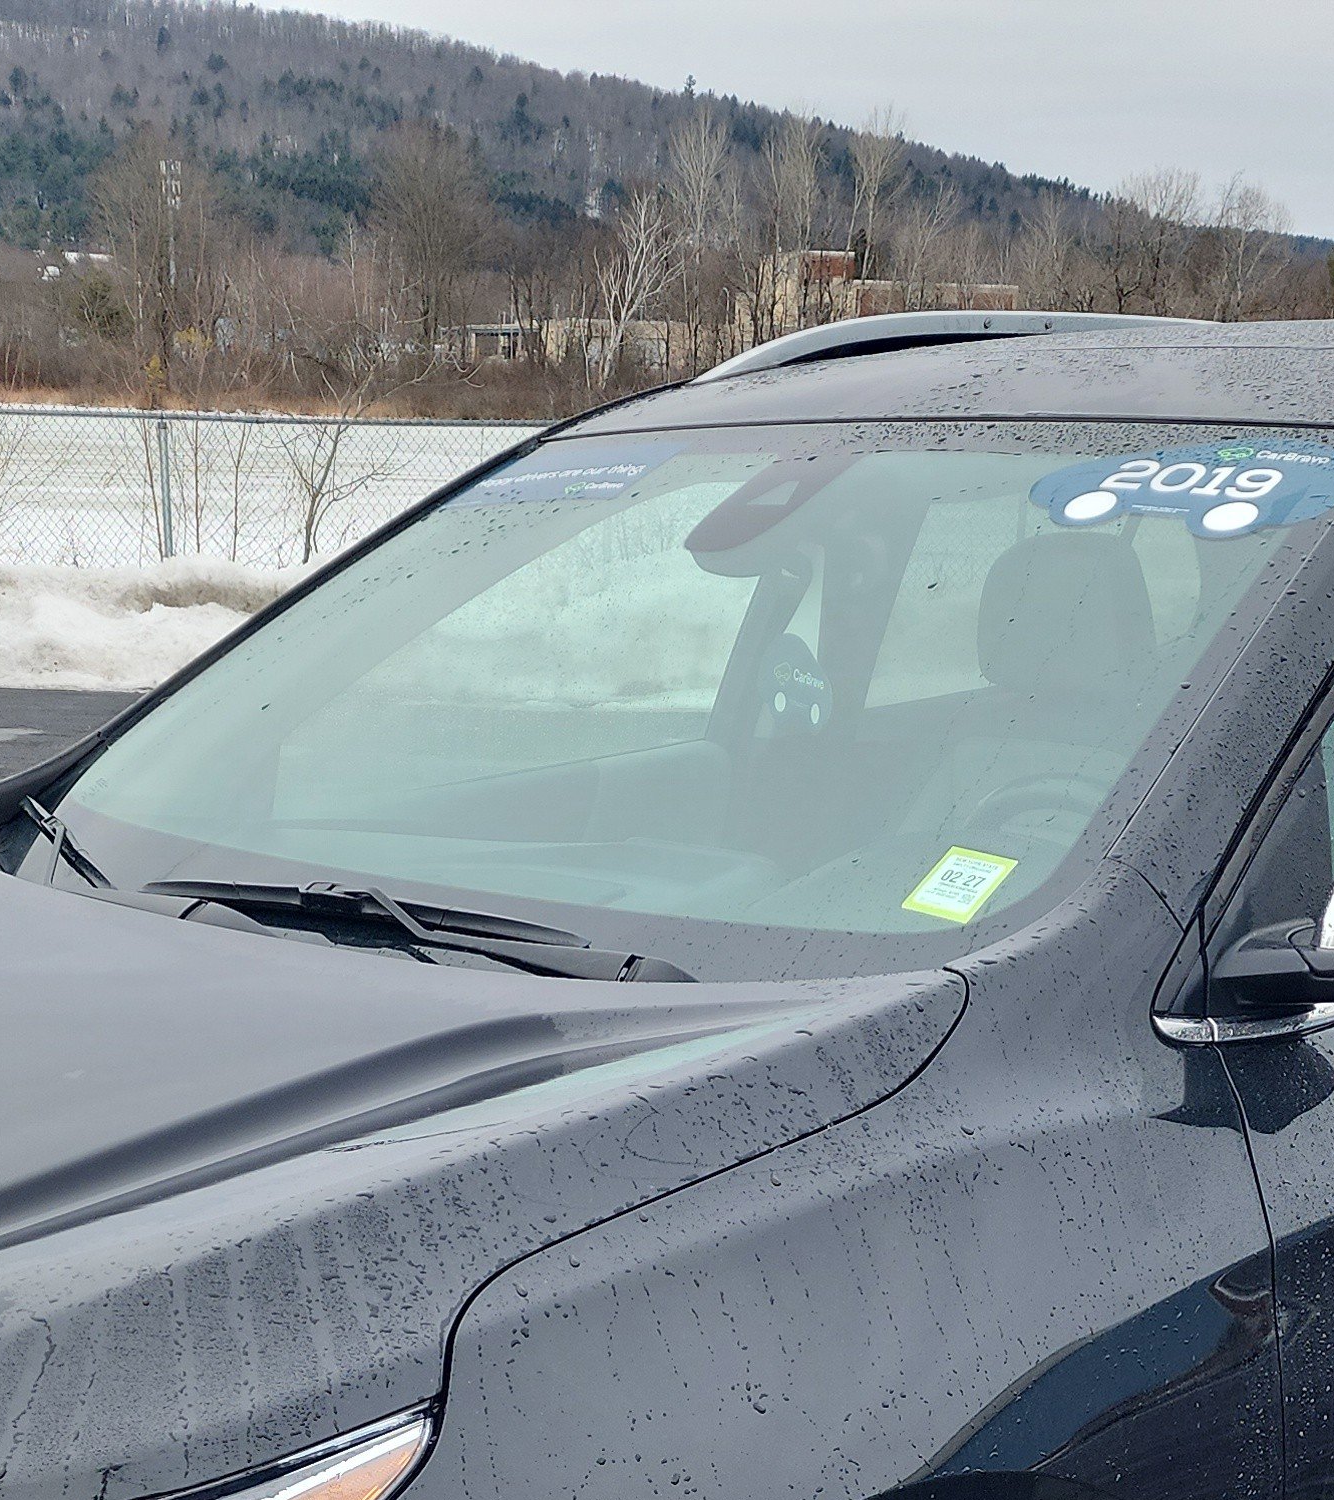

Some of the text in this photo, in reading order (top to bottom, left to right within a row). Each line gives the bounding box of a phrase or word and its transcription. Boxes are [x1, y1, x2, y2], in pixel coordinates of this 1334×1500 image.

[1255, 448, 1331, 466] CarBravo
[1098, 458, 1284, 499] 2019
[940, 869, 963, 883] 02
[962, 874, 986, 888] 27
